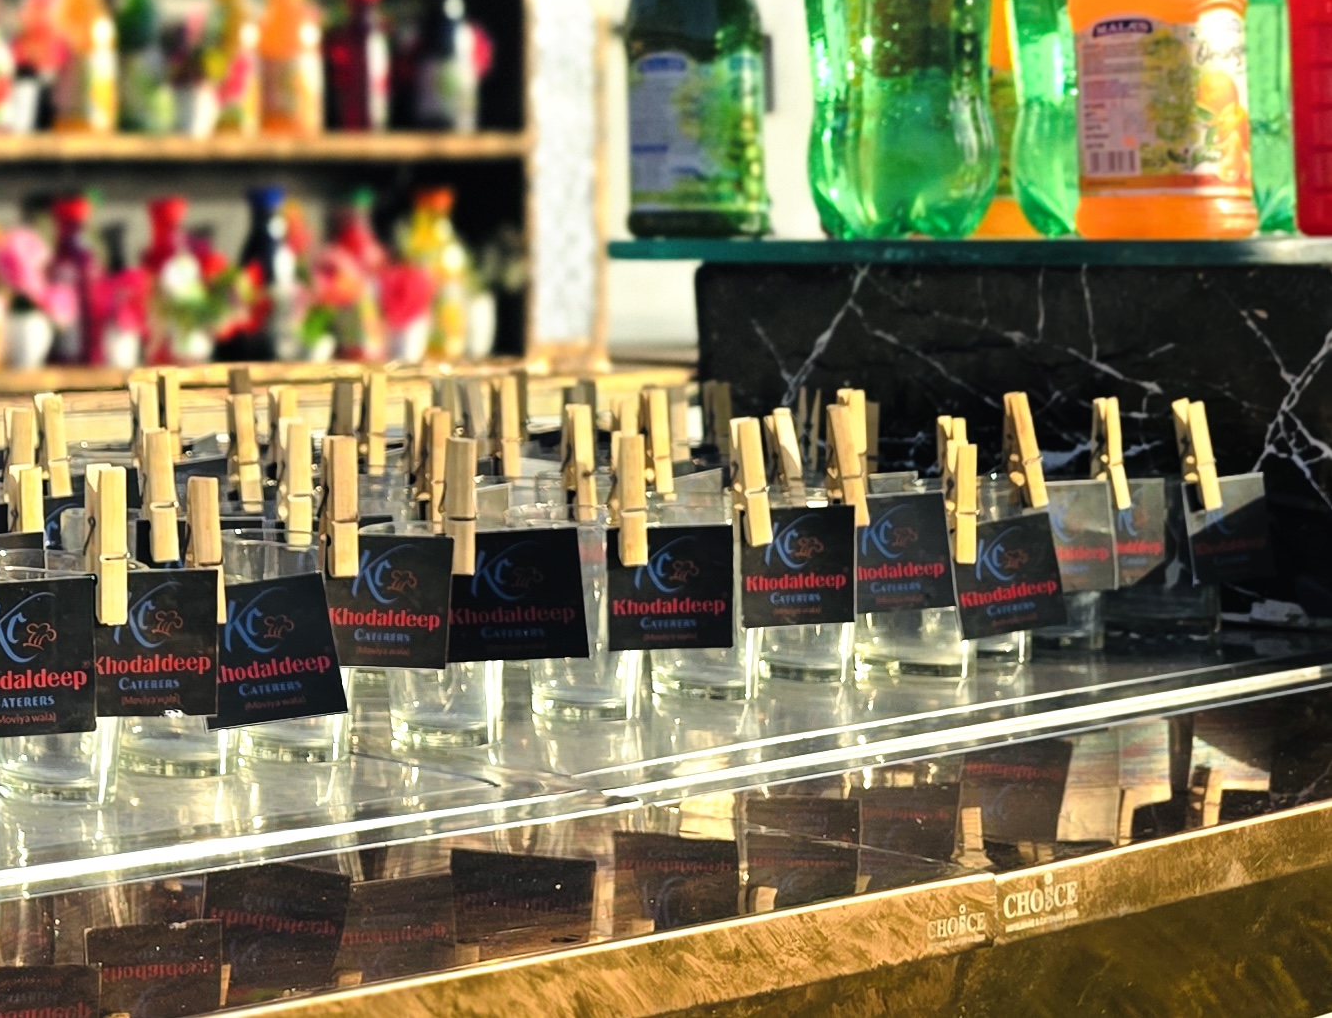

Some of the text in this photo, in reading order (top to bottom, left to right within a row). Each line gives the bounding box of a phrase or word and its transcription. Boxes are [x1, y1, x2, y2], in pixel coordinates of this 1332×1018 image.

[764, 515, 811, 569] KC
[861, 505, 901, 559] KC
[976, 528, 1014, 581] KC
[351, 545, 404, 604] KC
[746, 572, 847, 593] Khodaldeep
[857, 562, 945, 581] hodaldeep
[613, 596, 726, 617] Khodaldeep
[960, 580, 1057, 608] Khodaldeep
[224, 588, 277, 653] KC
[328, 607, 441, 632] Khodaldeep
[447, 606, 575, 625] Khodaldeep
[118, 677, 180, 690] CATERERS
[238, 680, 303, 696] CATERERS
